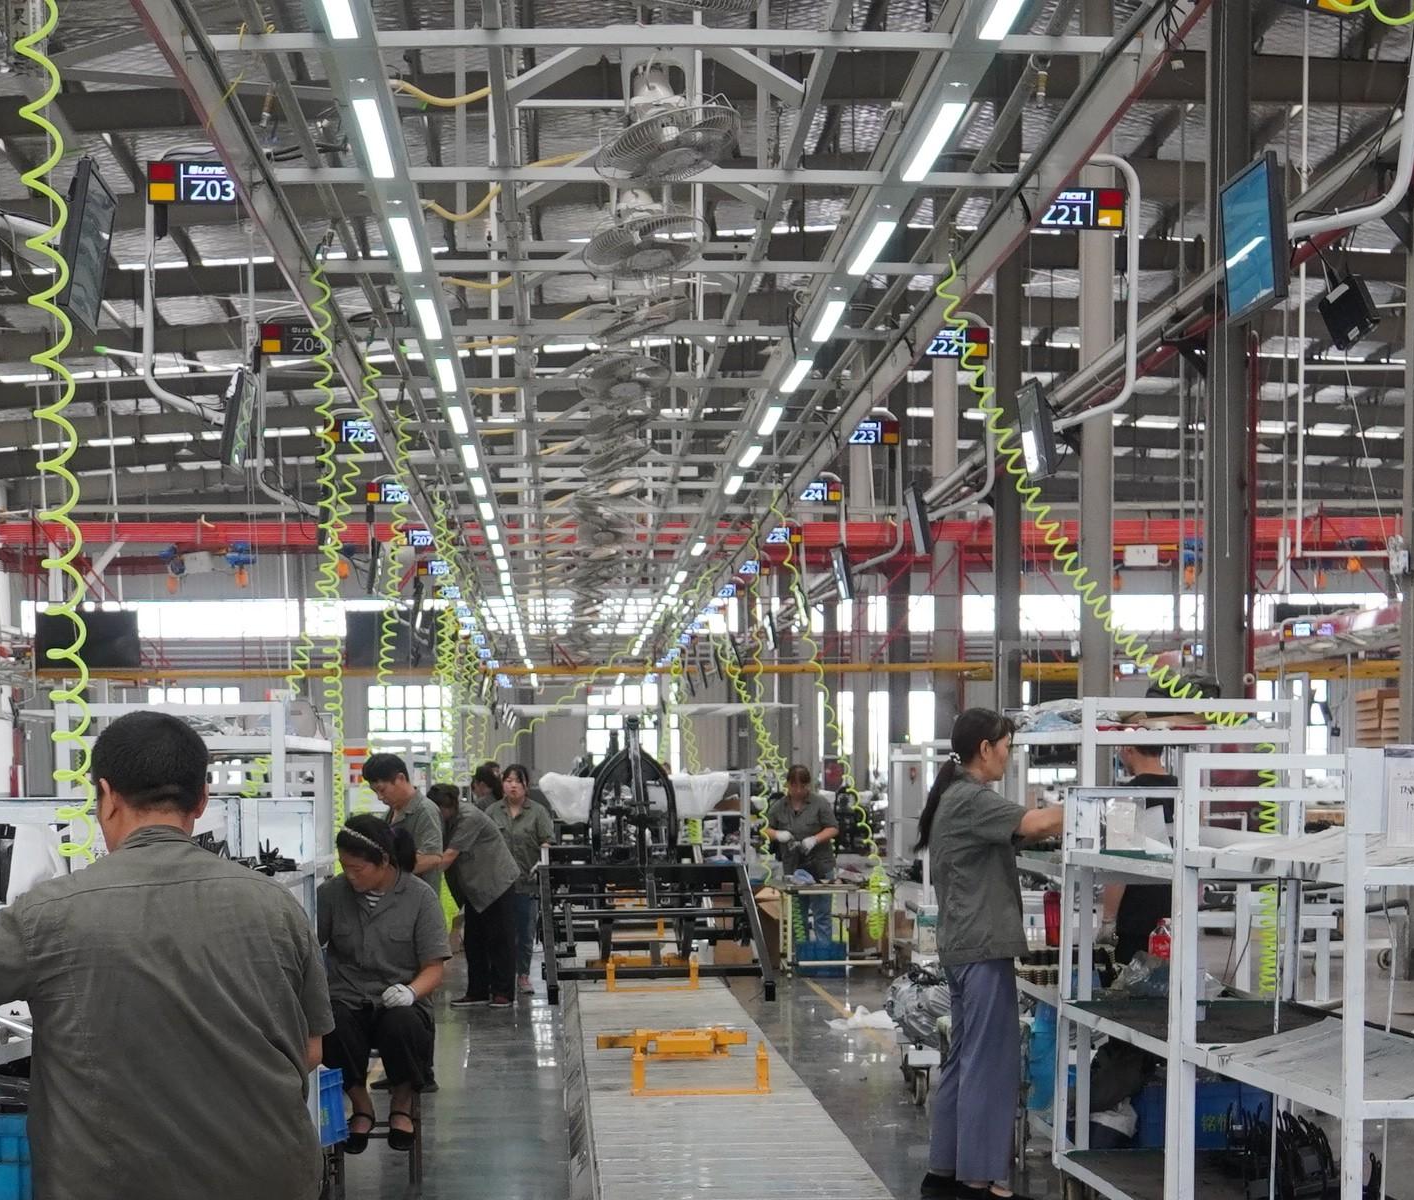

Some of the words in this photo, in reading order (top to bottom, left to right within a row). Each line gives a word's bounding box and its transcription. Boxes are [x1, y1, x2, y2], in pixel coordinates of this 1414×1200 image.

[190, 180, 235, 201] Z03
[1041, 205, 1083, 225] Z21
[292, 337, 324, 352] Z04
[926, 340, 958, 355] Z22
[349, 429, 375, 442] Z05
[849, 430, 875, 443] Z23
[387, 491, 409, 502] Z06
[413, 535, 433, 546] Z07
